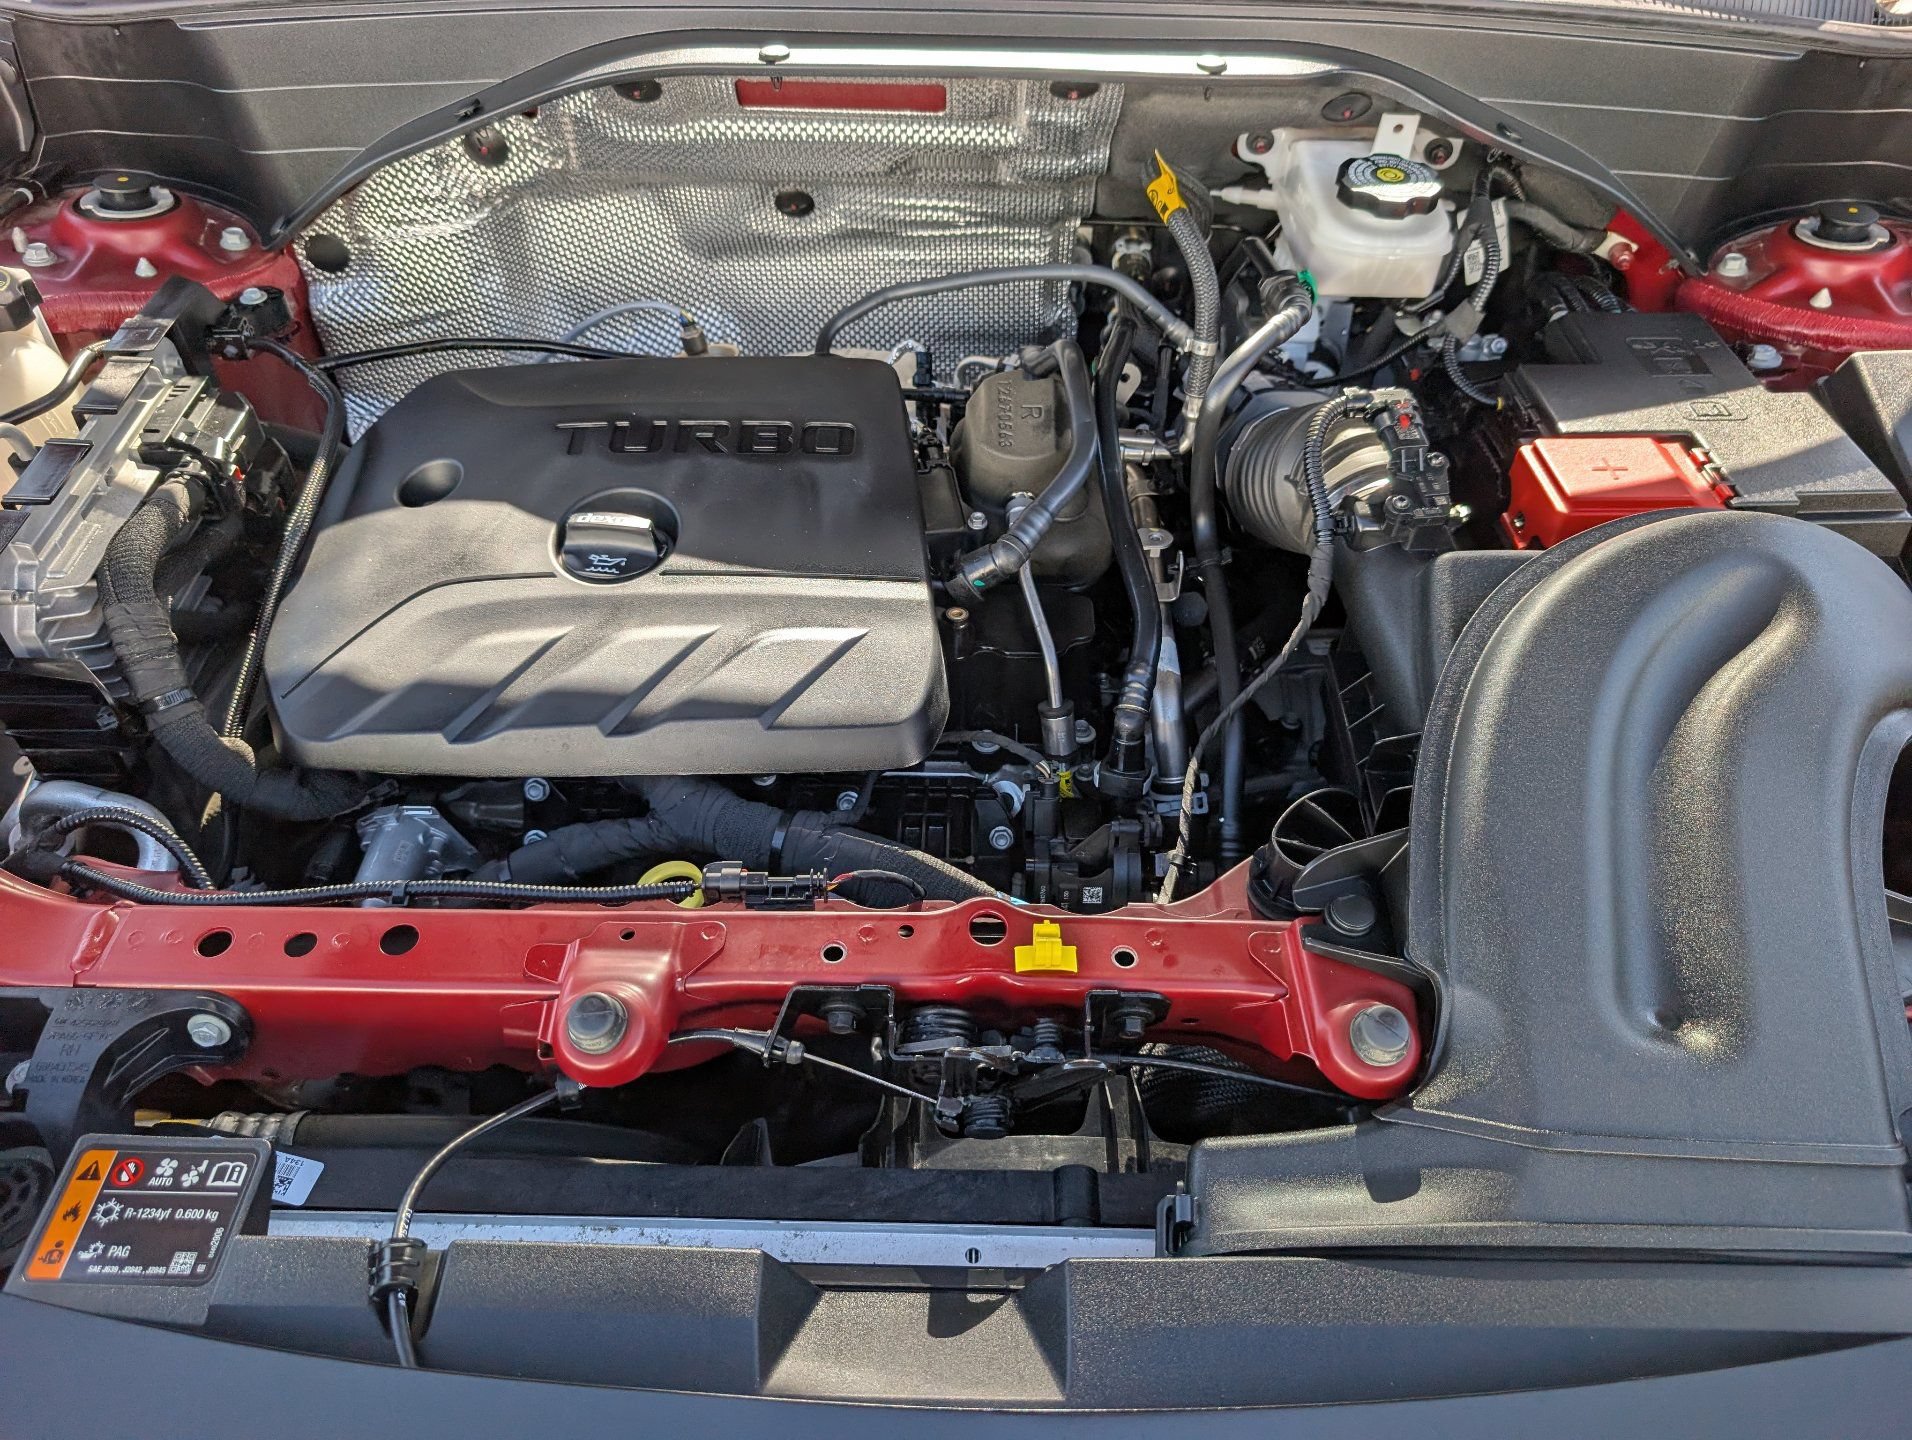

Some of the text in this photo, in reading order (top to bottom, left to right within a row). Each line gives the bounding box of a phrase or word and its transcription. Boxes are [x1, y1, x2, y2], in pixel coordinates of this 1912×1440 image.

[555, 419, 857, 456] TURBO
[147, 1177, 173, 1187] AUTO
[124, 1207, 219, 1222] R-1234yf 0.600 kg
[107, 1245, 131, 1257] PAG
